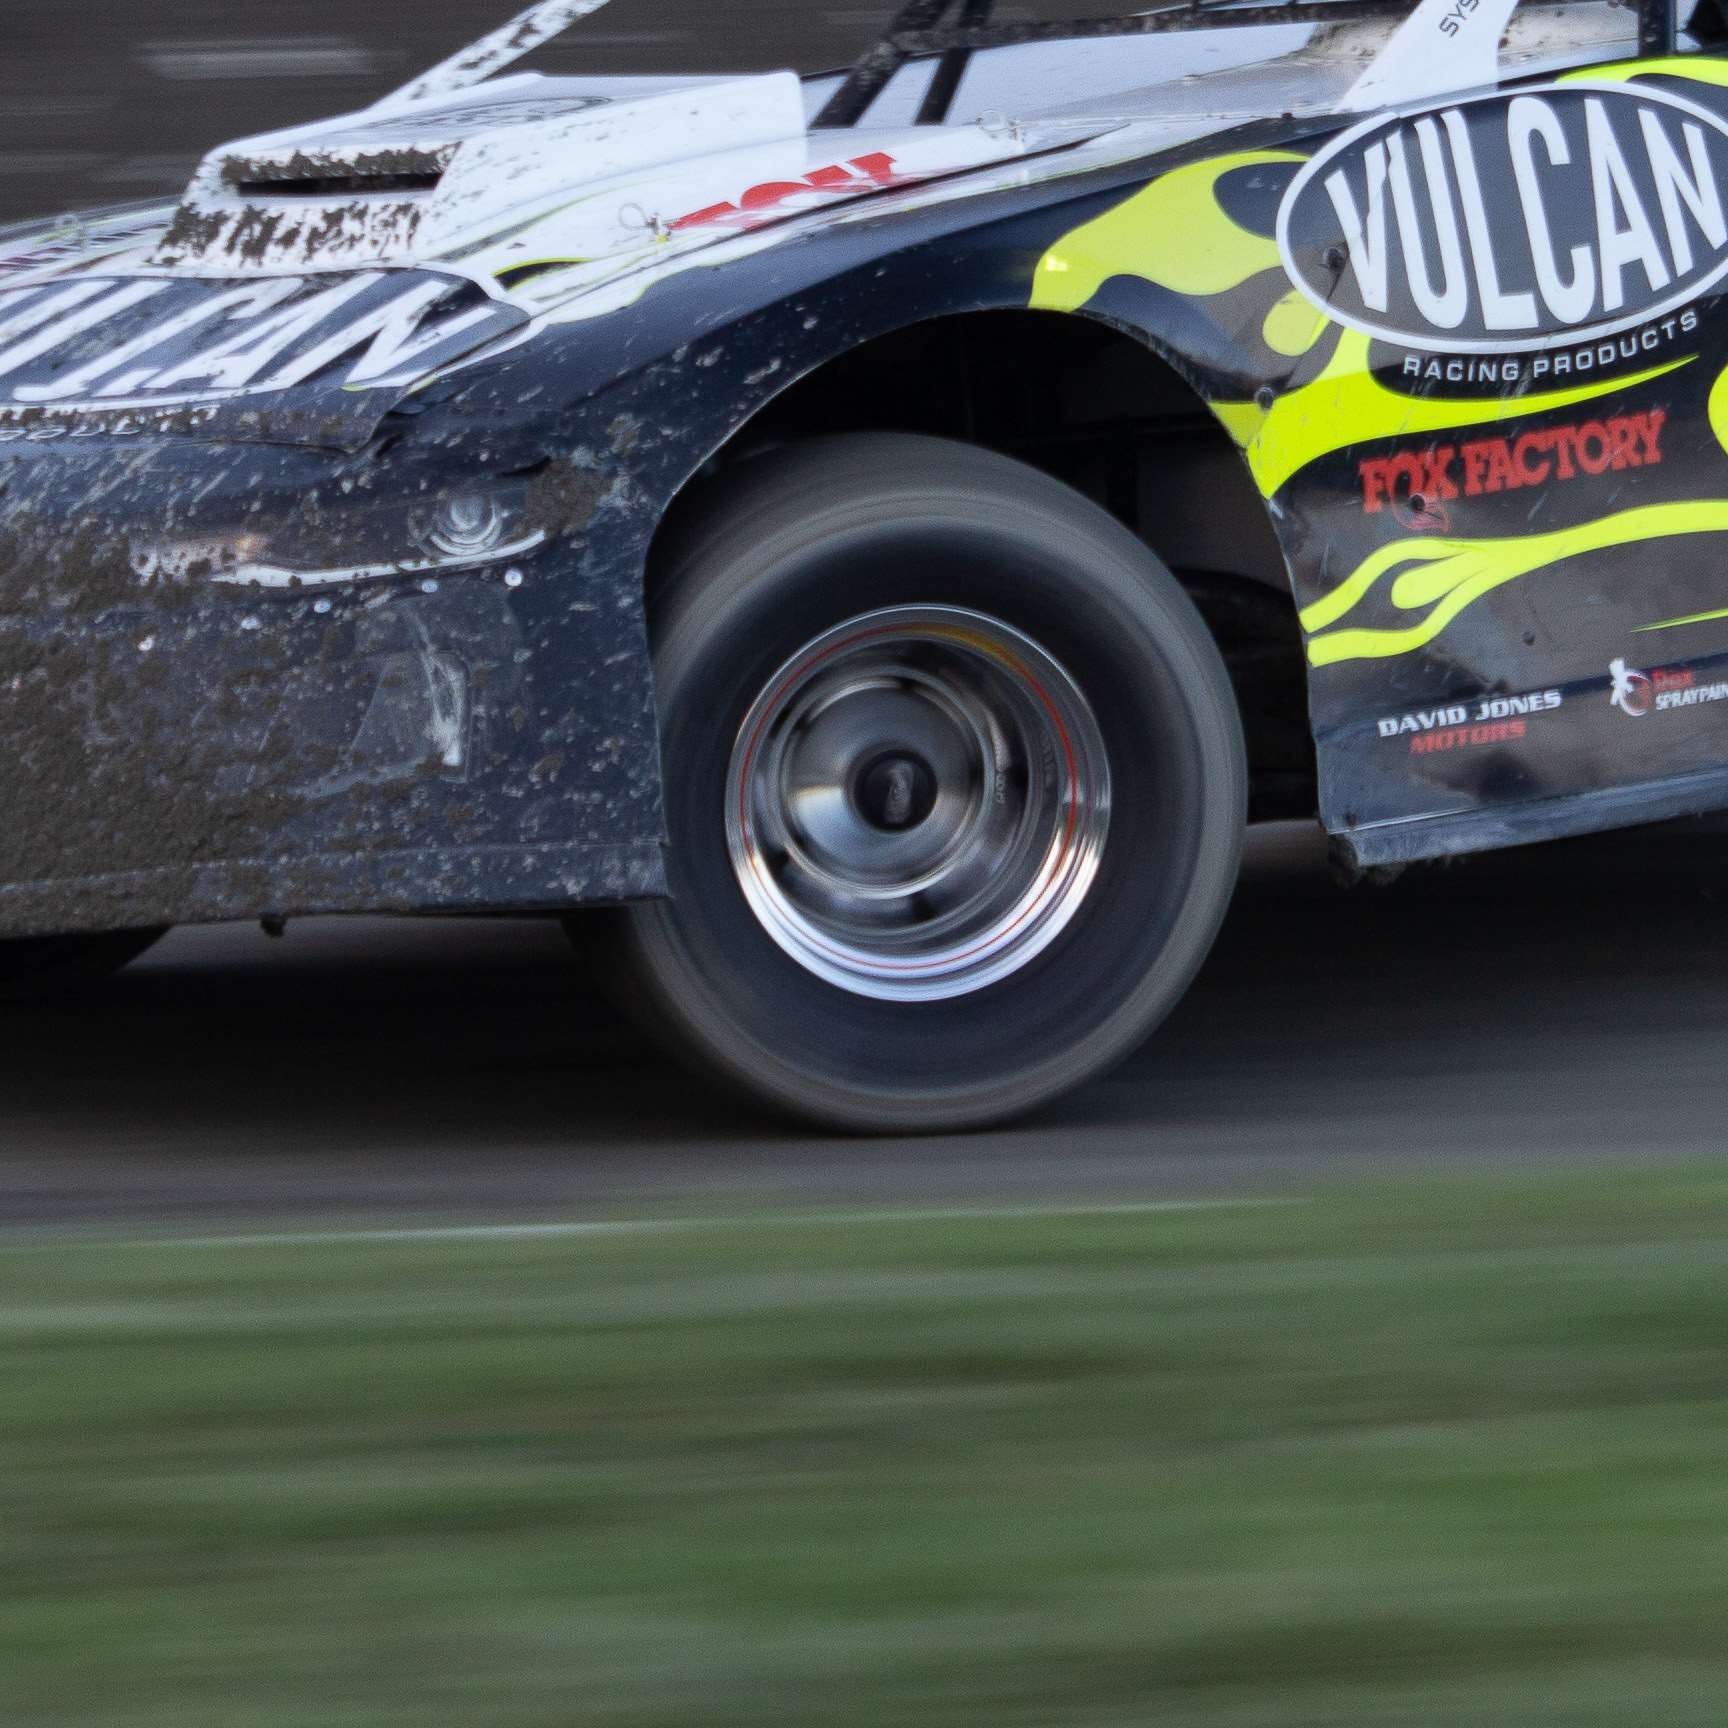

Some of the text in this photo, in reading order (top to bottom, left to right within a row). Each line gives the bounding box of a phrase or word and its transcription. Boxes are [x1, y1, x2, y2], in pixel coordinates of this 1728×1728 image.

[1403, 311, 1699, 383] RACING PRODUCTS
[1359, 407, 1668, 514] FOX FACTORY
[1377, 688, 1564, 737] DAVID JONES
[1408, 720, 1528, 754] MOTORS
